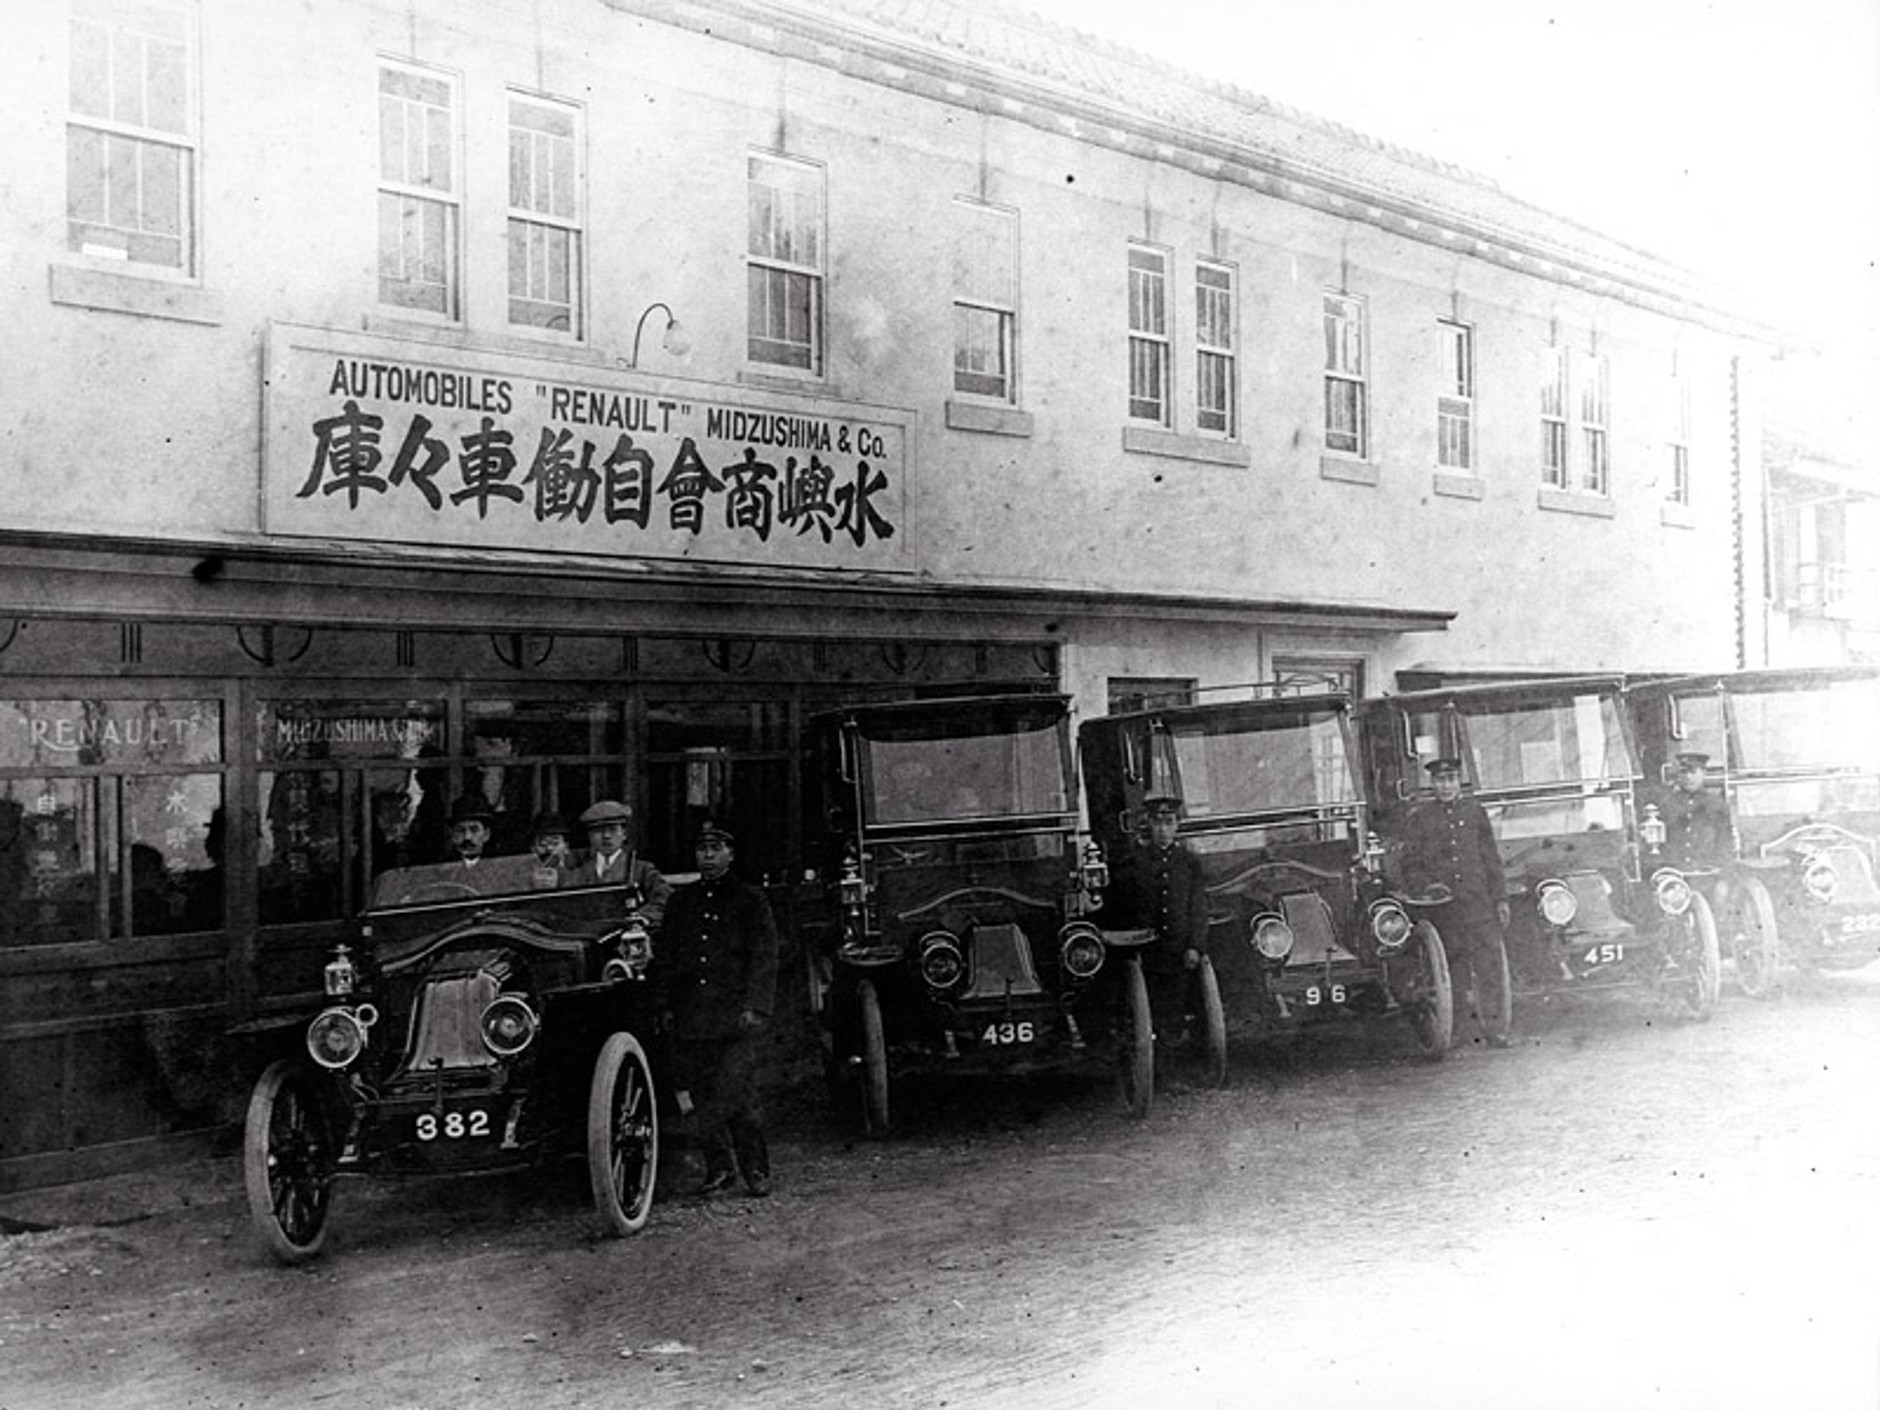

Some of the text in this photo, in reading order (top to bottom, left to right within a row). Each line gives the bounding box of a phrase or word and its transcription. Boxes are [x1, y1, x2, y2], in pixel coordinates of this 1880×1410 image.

[329, 359, 888, 460] AUTOMOBILES "RENAULT" MIDZUSHIMA & Co.
[1584, 944, 1623, 965] 451
[1306, 984, 1346, 1005] 96
[982, 1022, 1034, 1045] 436
[416, 1109, 490, 1141] 382
